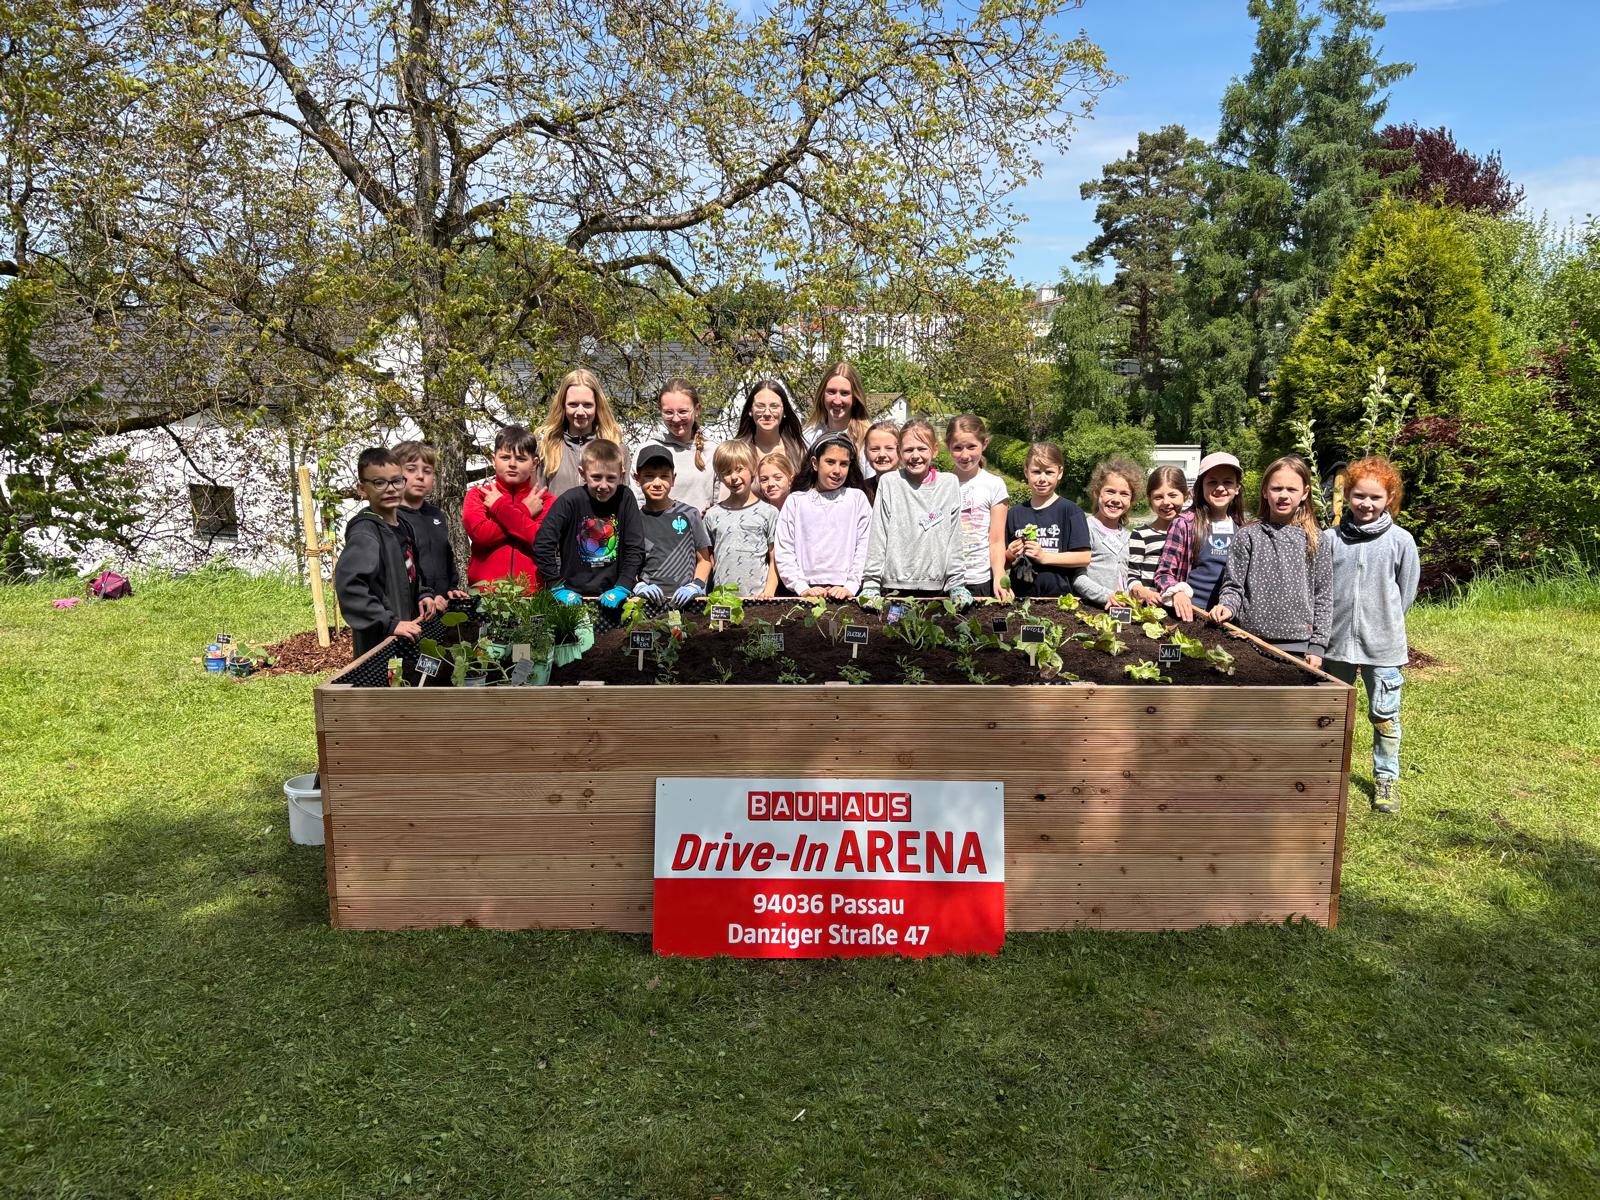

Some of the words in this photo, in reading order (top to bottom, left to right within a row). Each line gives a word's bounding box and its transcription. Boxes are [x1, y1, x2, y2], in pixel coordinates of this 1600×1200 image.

[1160, 647, 1180, 658] SALAT
[750, 794, 908, 819] BAUHAUS
[671, 832, 829, 872] Drive-In
[834, 830, 987, 874] ARENA
[753, 893, 824, 914] 94036
[830, 893, 905, 915] Passau
[728, 922, 823, 949] Danziger
[828, 923, 899, 945] Straße
[904, 925, 931, 946] 47
